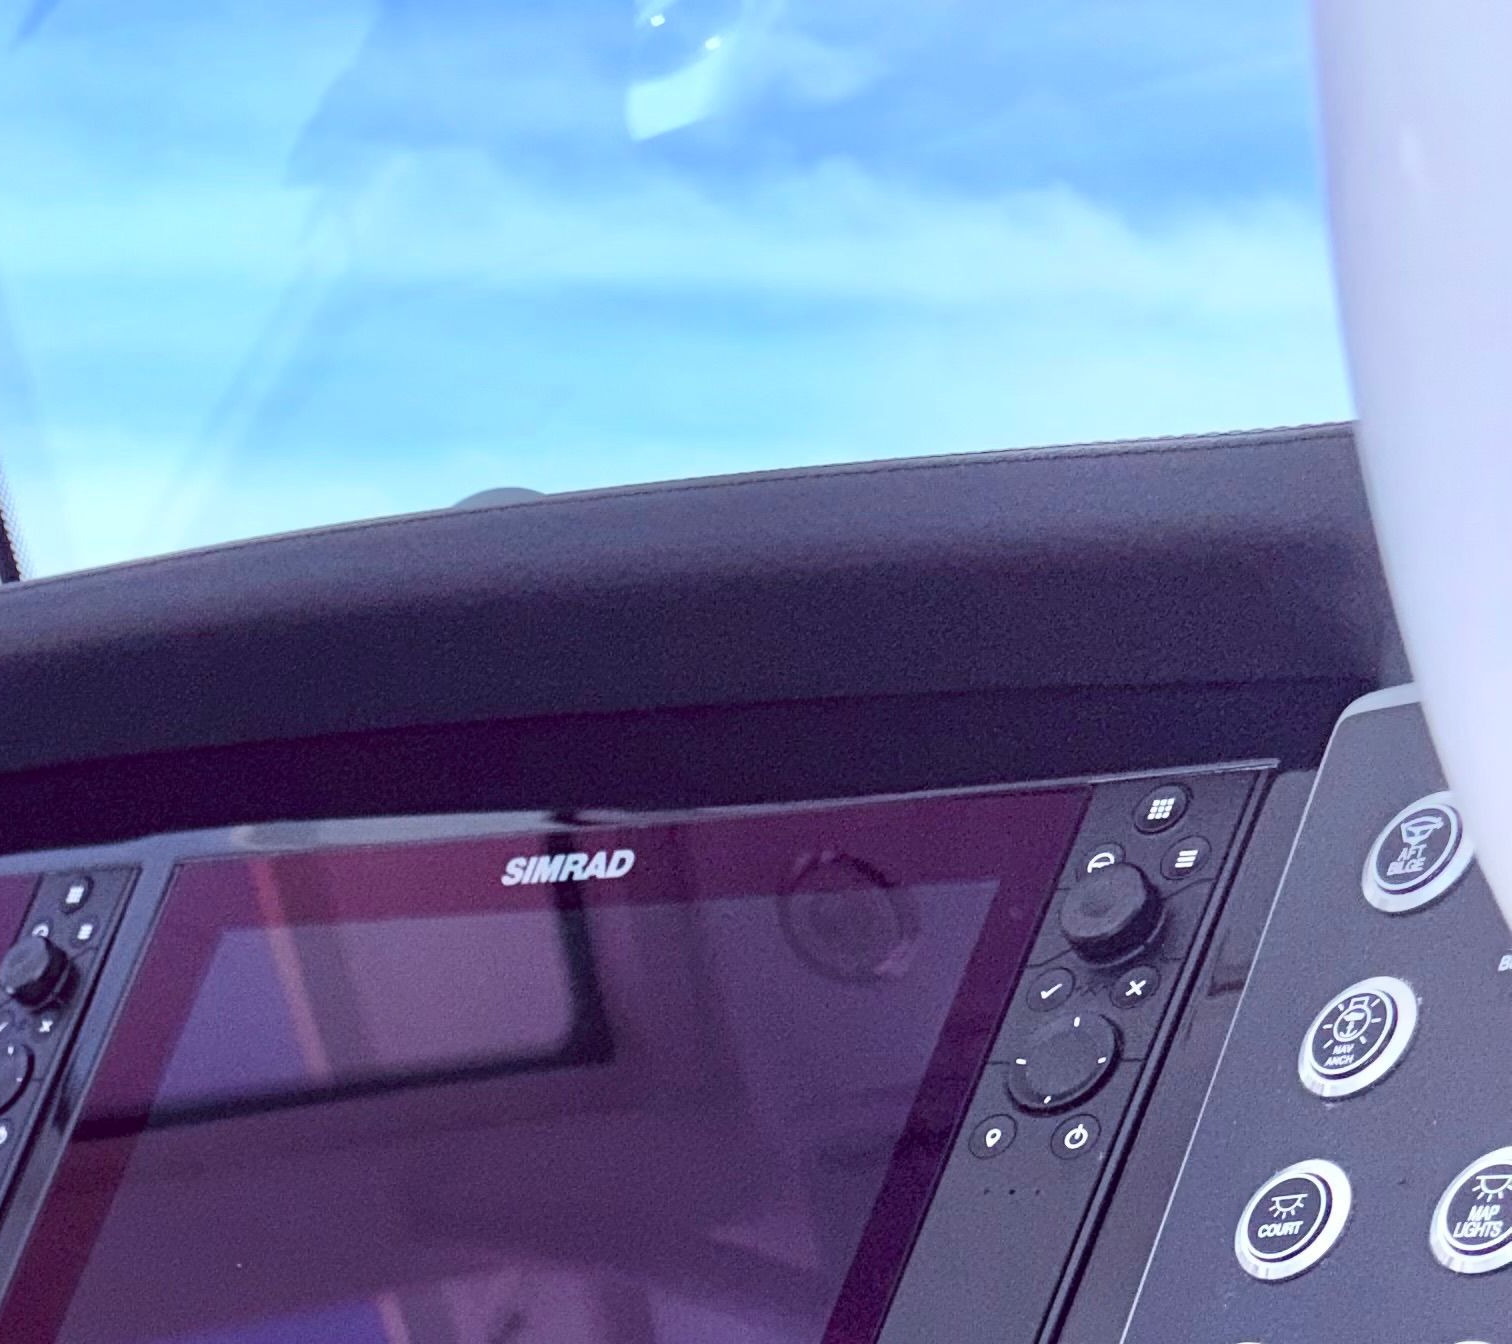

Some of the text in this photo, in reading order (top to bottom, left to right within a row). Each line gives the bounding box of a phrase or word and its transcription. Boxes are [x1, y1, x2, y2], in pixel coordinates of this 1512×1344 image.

[1398, 845, 1424, 861] AFT
[500, 848, 636, 887] SIMRAD
[1387, 858, 1424, 875] BILGE
[1332, 1044, 1356, 1057] NAV
[1323, 1054, 1356, 1068] ANCH
[1468, 1205, 1500, 1222] MAP
[1257, 1220, 1304, 1238] COURT
[1453, 1220, 1503, 1238] LIGHTS
